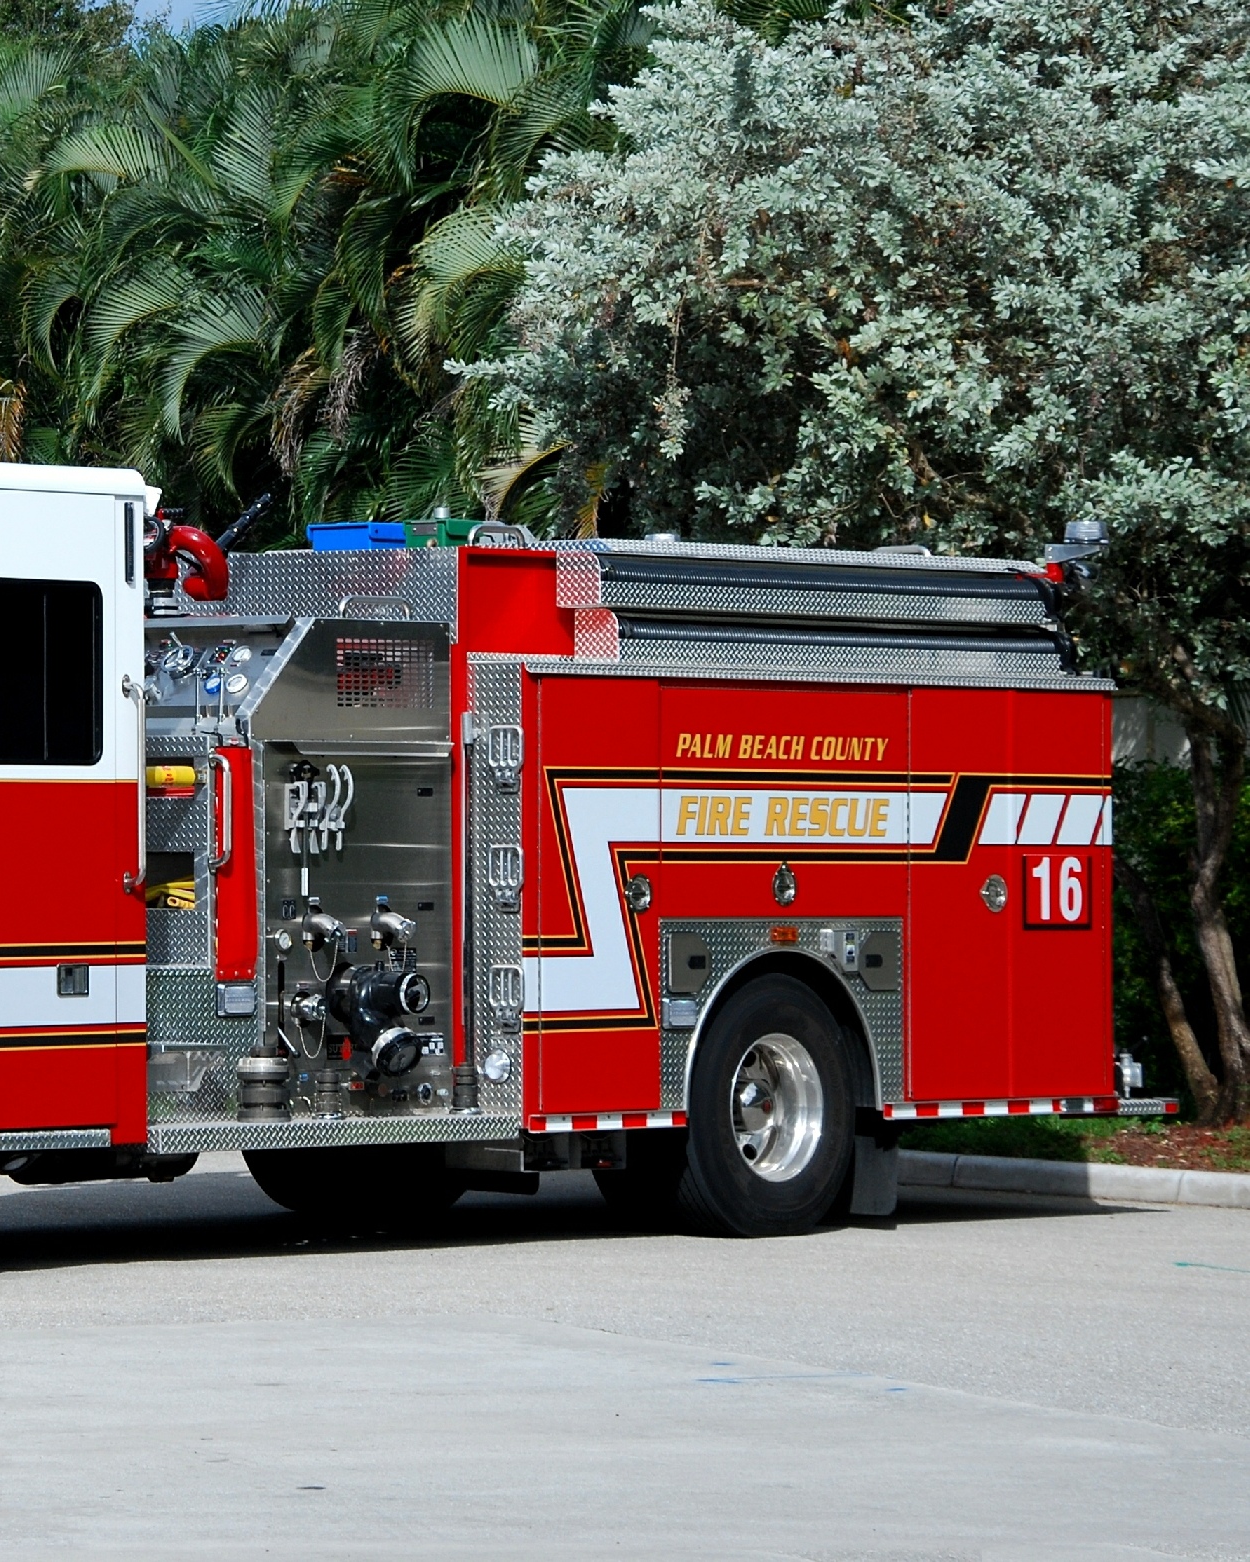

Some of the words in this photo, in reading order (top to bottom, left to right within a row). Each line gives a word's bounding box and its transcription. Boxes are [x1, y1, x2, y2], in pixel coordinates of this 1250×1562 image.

[675, 733, 733, 759] PALM
[737, 735, 806, 760] BEACH
[810, 736, 889, 761] COUNTY
[676, 795, 753, 836] FIRE
[764, 796, 890, 838] RESCUE
[1032, 856, 1083, 922] 16
